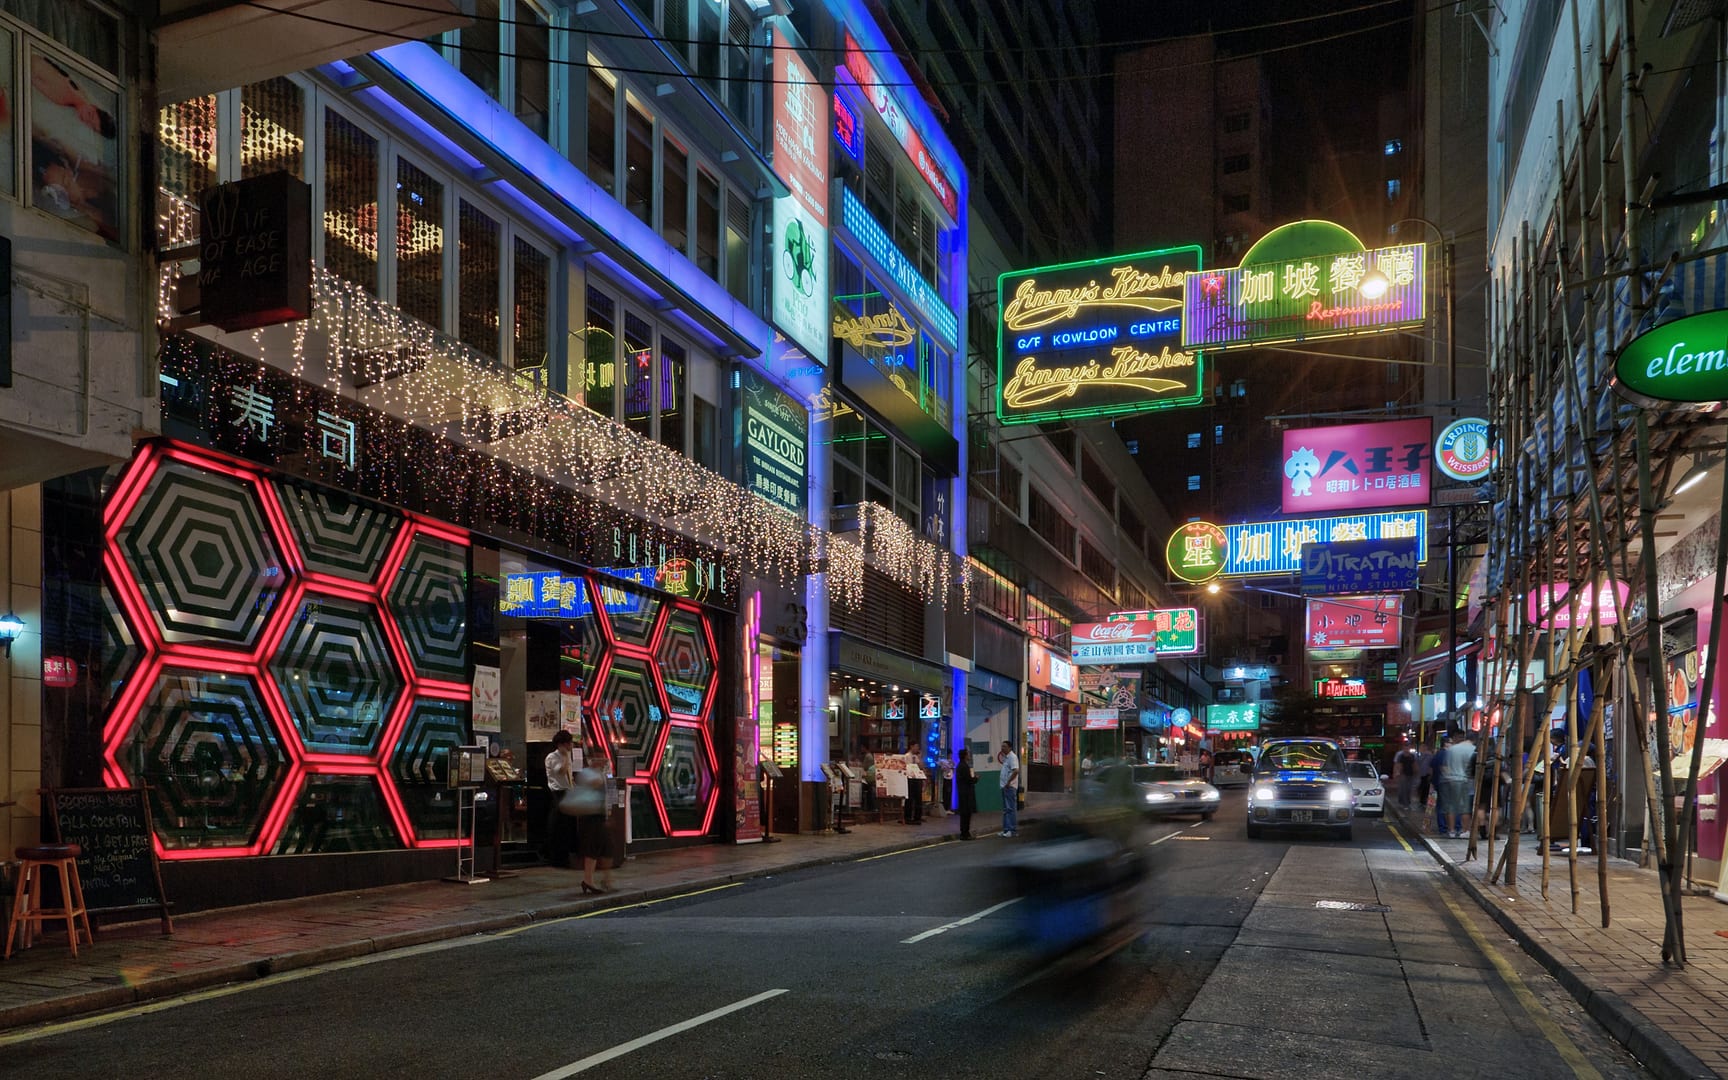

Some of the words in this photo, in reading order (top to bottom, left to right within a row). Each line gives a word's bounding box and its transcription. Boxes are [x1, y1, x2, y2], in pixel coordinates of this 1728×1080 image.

[896, 261, 917, 297] MIX
[1004, 279, 1100, 322] Jimmy's
[1103, 265, 1185, 299] Kitche
[1017, 336, 1041, 350] G/F
[1053, 327, 1117, 346] KOWLOON
[1130, 319, 1180, 335] CENTRE
[1647, 342, 1728, 378] elem
[1004, 357, 1100, 400] Jimmy's
[748, 418, 805, 466] GAYLORD
[1445, 424, 1488, 447] ERDINGE
[1319, 443, 1431, 478] 八王子
[1326, 473, 1421, 493] 昭和レトロ居酒屋
[1182, 534, 1216, 568] 星
[1368, 580, 1413, 589] STUDIO
